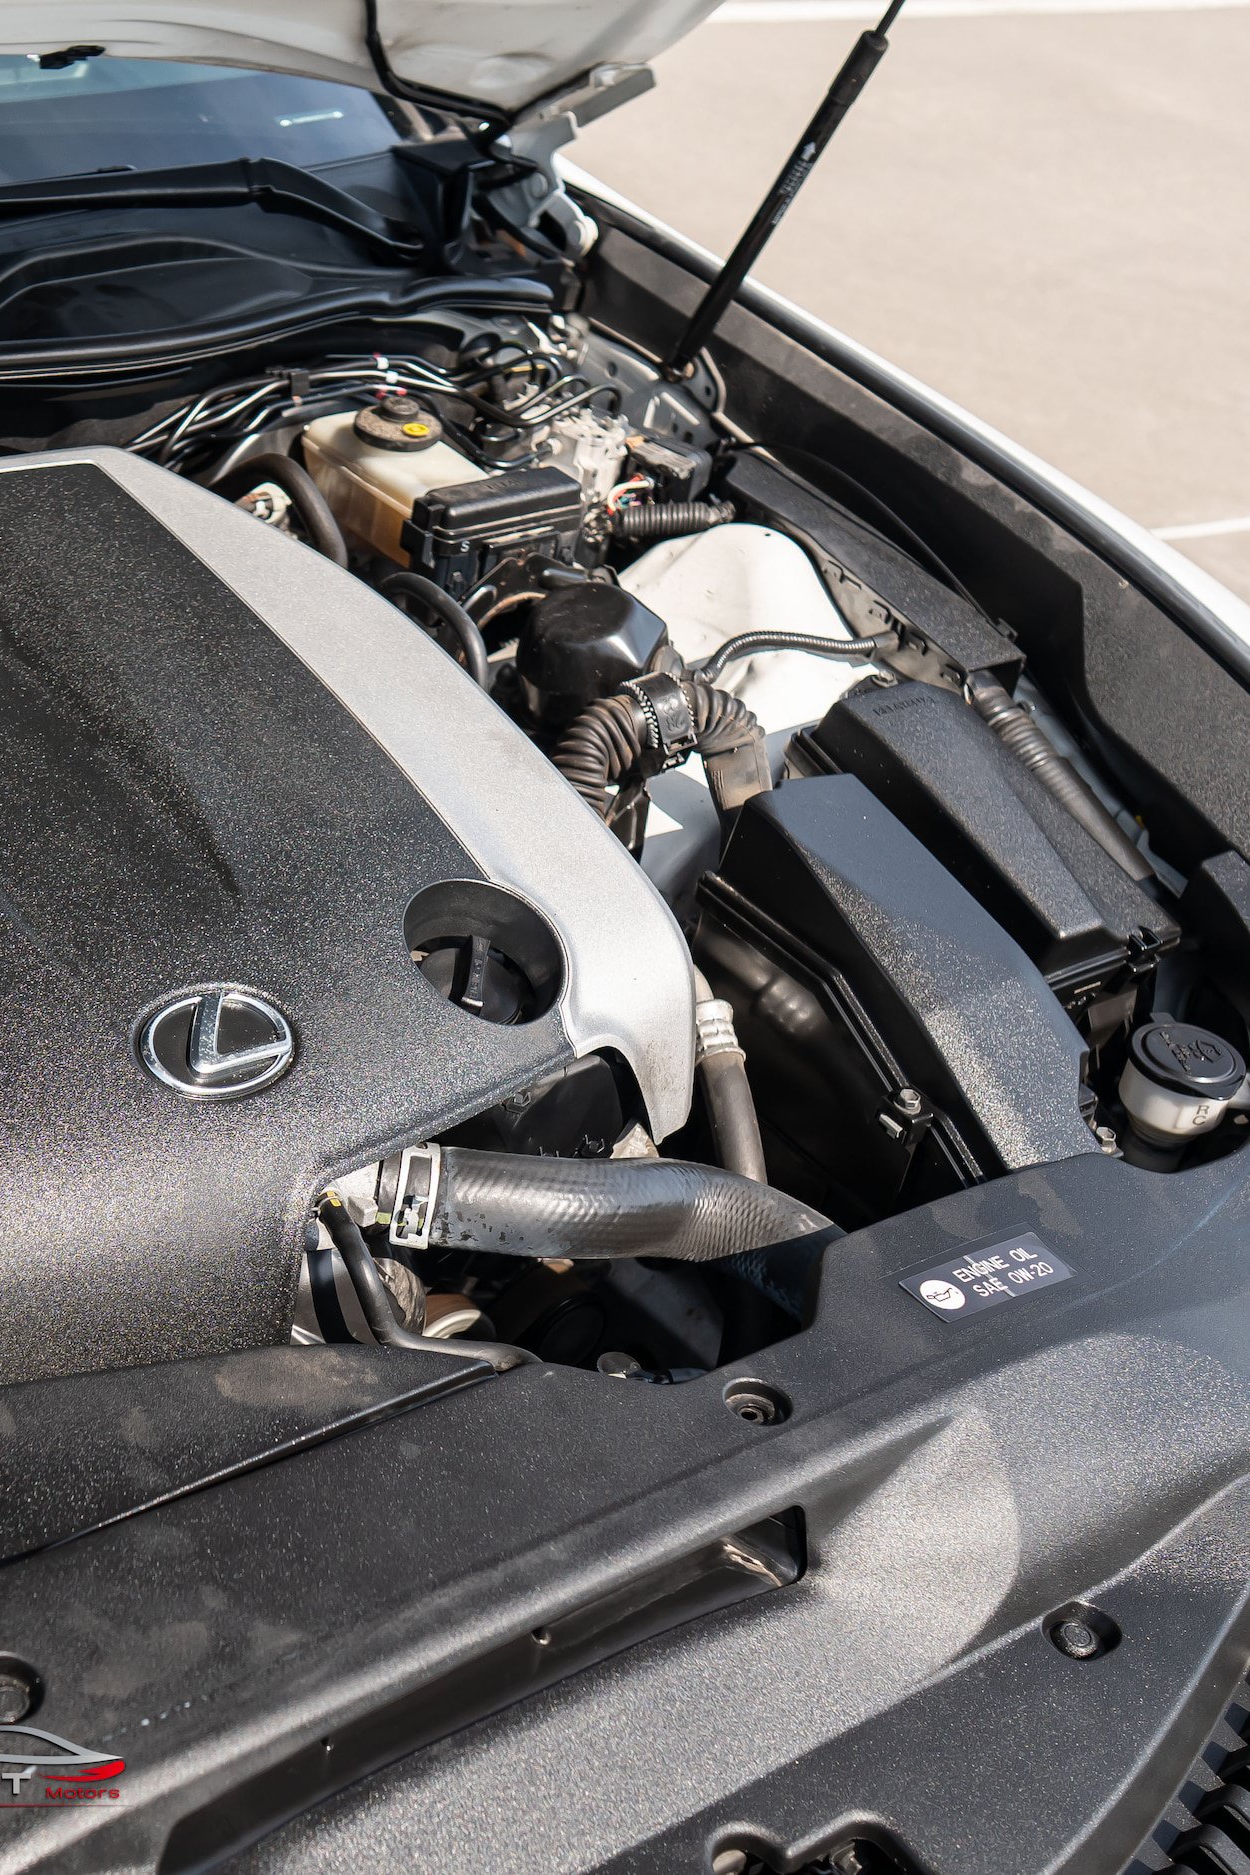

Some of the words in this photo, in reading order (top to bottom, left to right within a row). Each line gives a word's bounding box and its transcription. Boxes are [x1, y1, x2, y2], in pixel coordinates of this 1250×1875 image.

[952, 1255, 1010, 1283] ENGINE
[1008, 1247, 1038, 1263] OIL
[972, 1277, 1009, 1298] SAE
[1007, 1261, 1054, 1284] 0W-20
